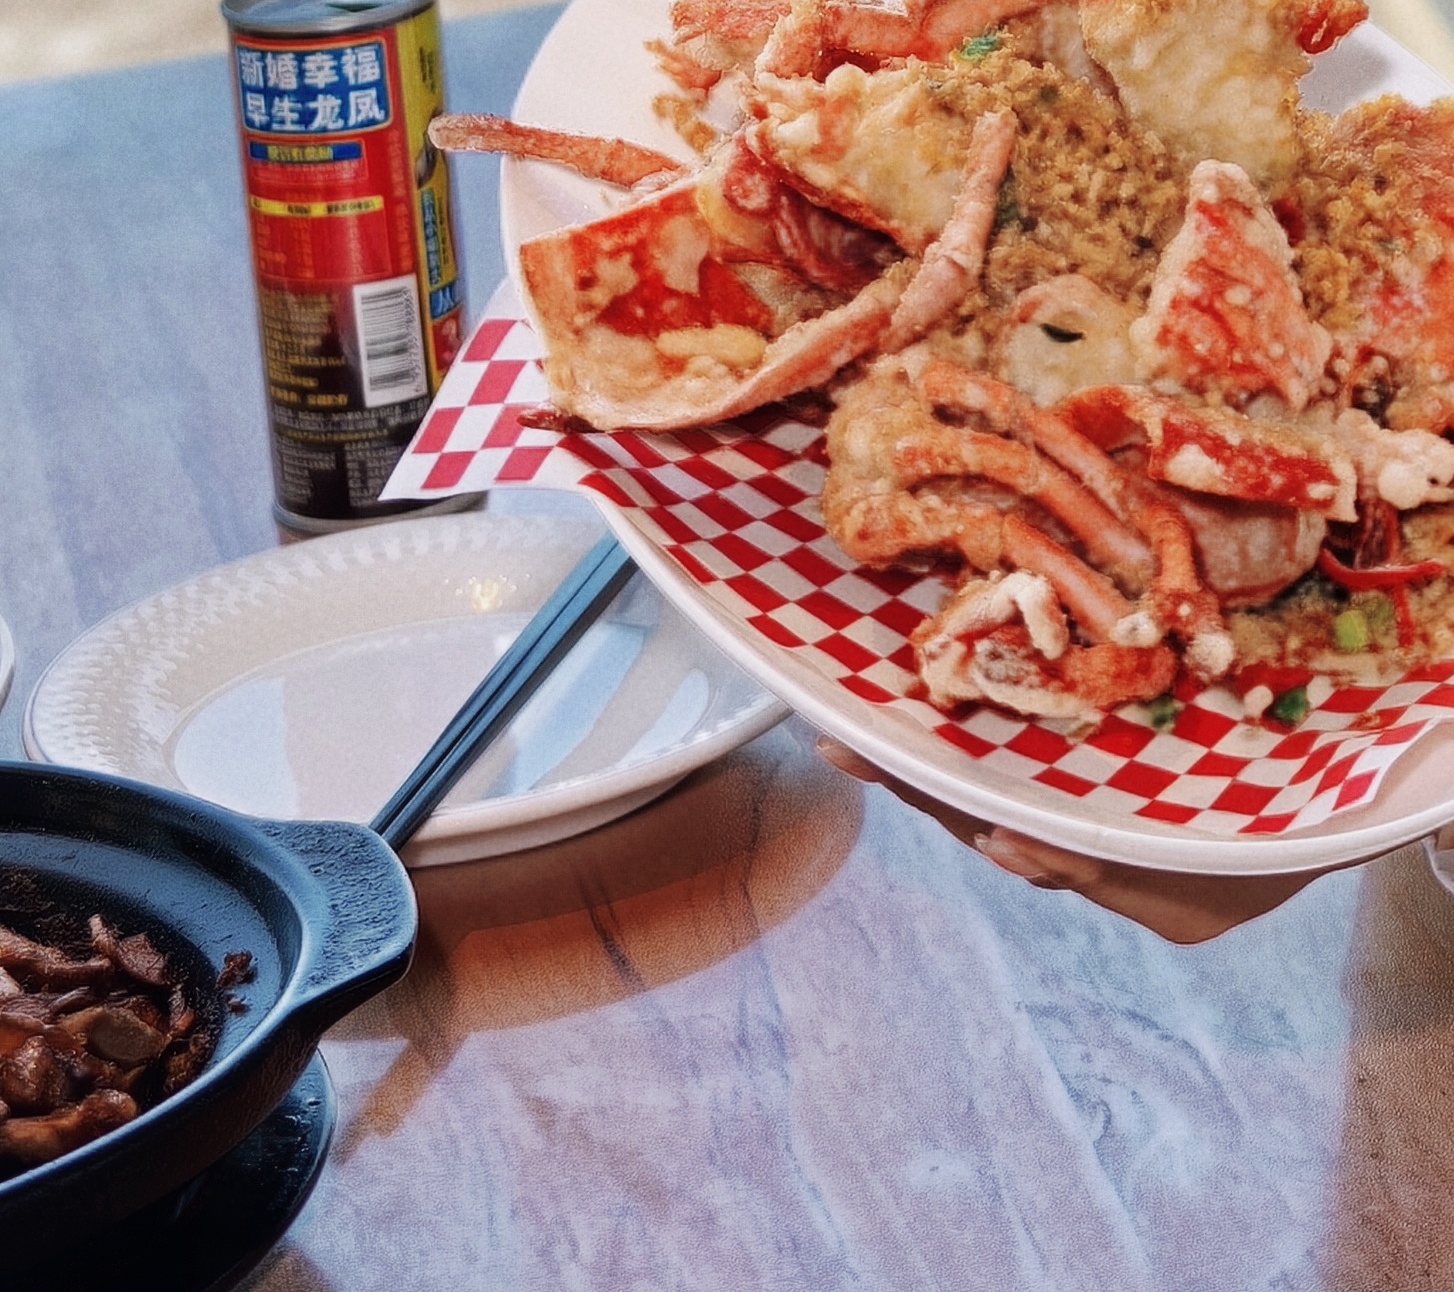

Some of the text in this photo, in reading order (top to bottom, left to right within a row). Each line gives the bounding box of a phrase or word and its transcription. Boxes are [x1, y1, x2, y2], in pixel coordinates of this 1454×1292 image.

[239, 45, 381, 90] 新婚幸福
[245, 87, 385, 131] 早生龙凤
